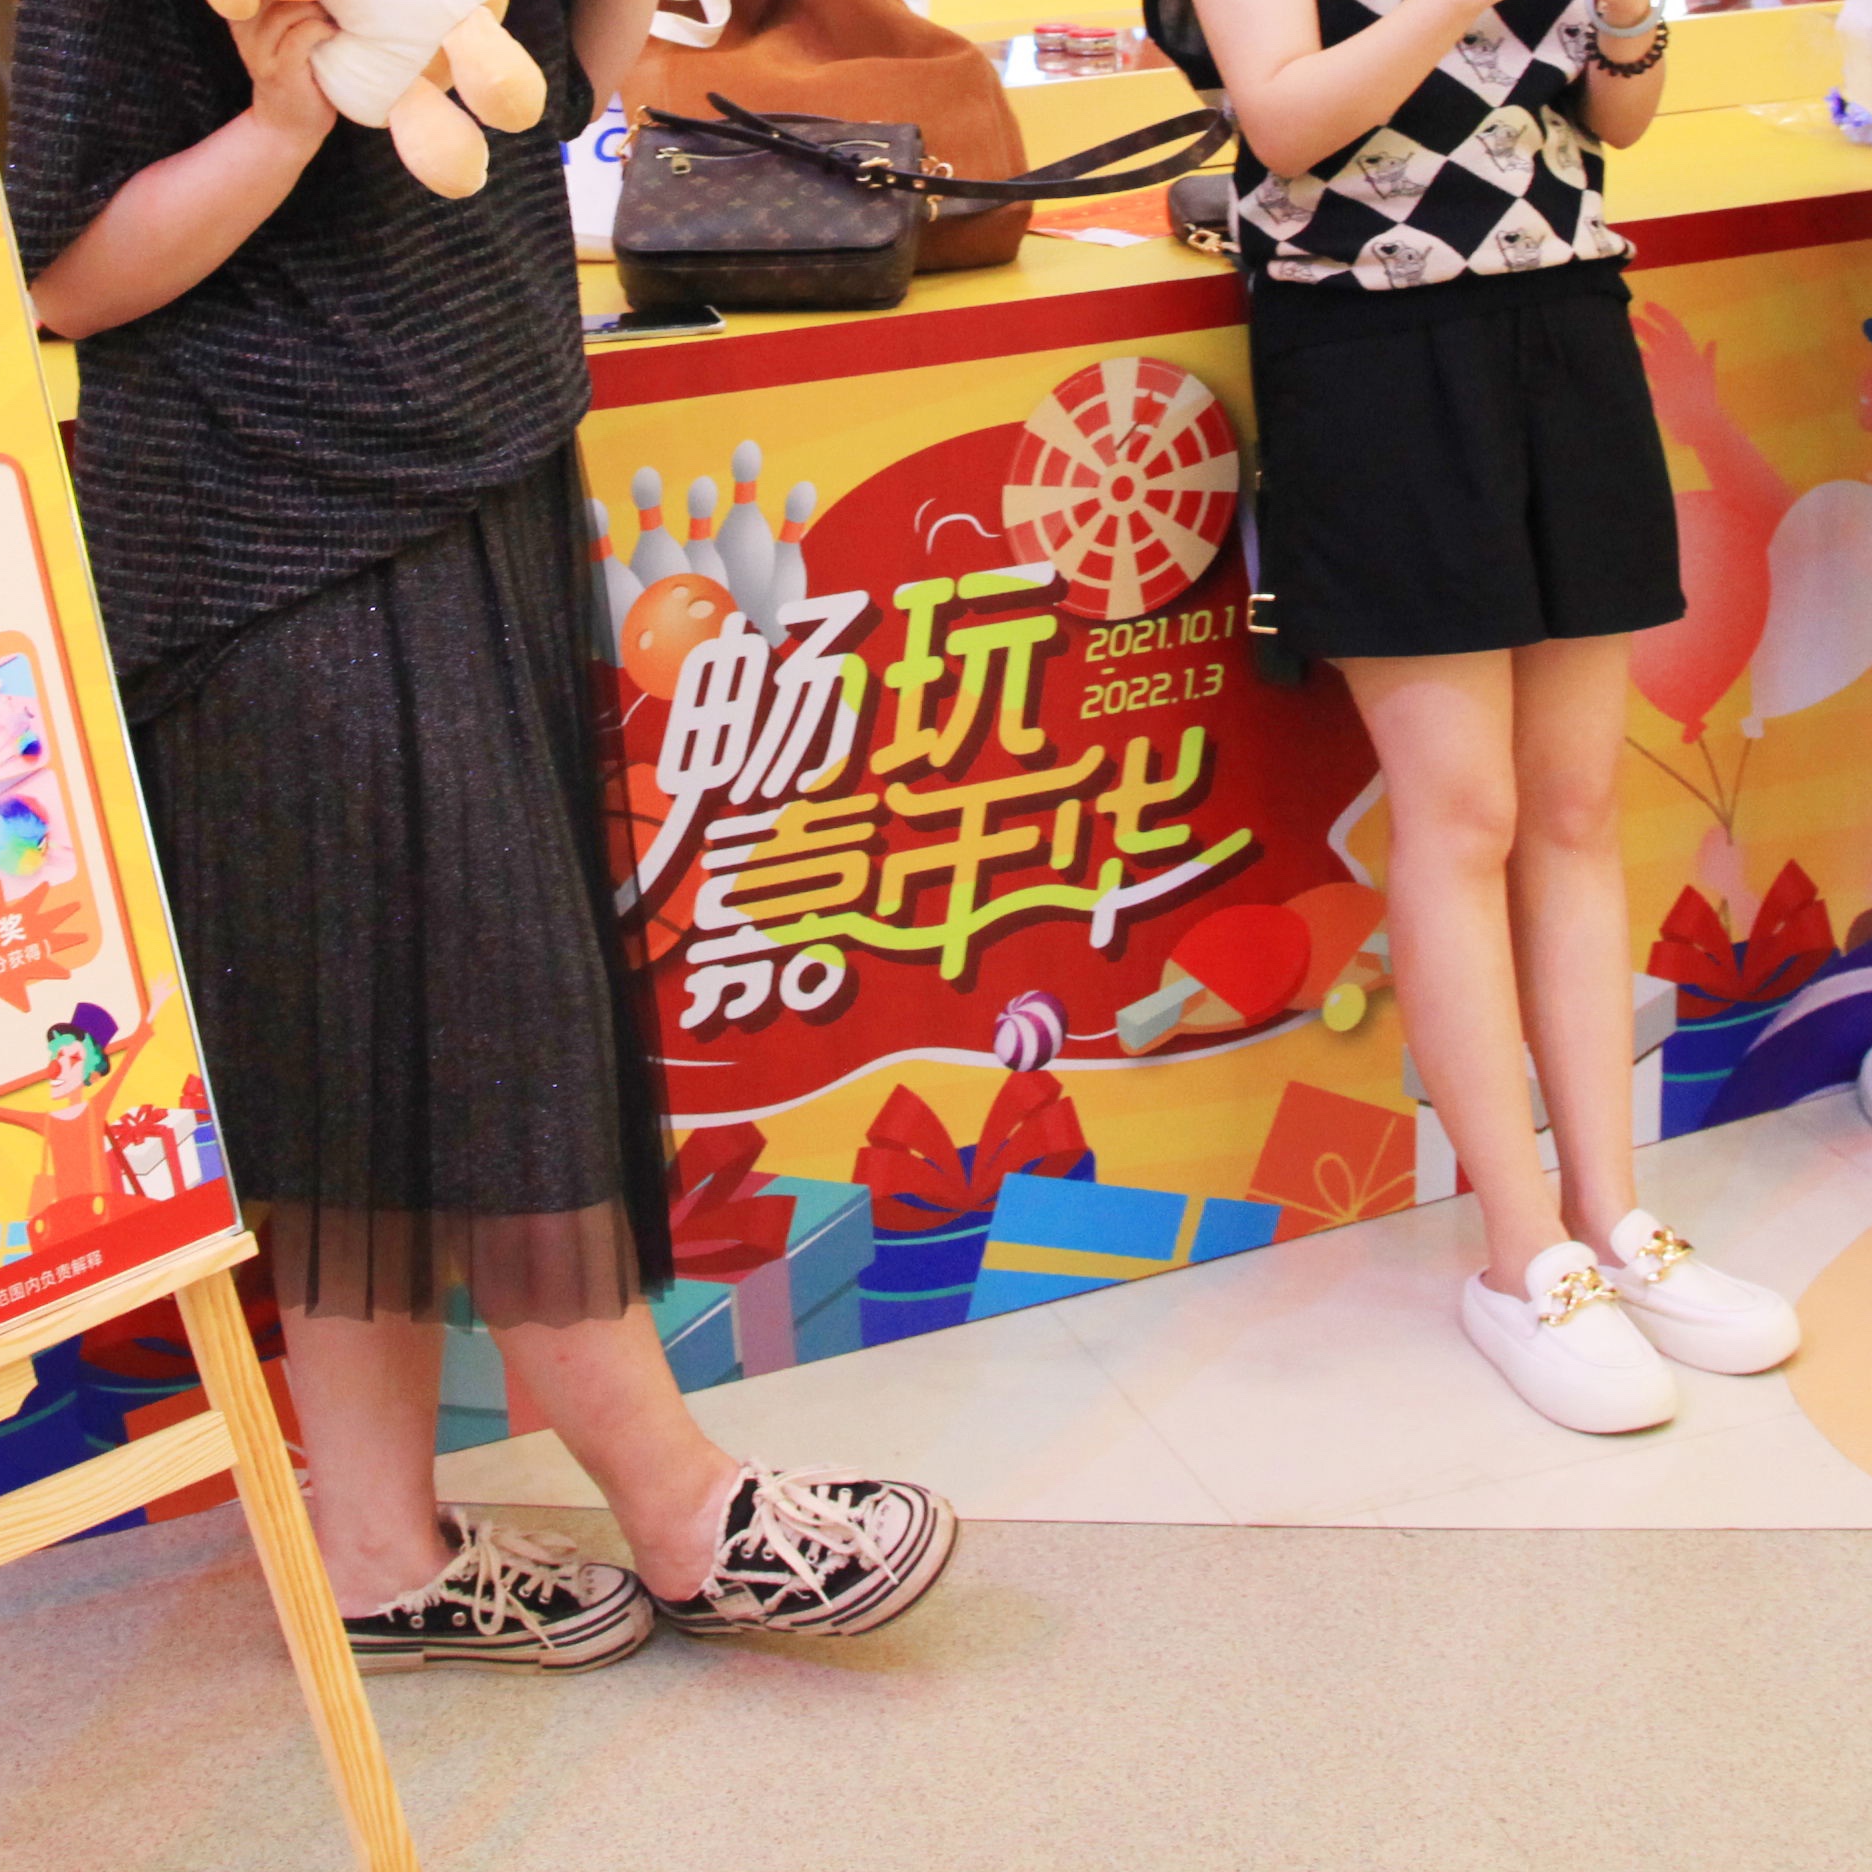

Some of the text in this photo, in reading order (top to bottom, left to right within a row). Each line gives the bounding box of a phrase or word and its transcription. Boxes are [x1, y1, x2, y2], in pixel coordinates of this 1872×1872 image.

[1079, 663, 1225, 720] 2022.1.3
[1084, 605, 1236, 664] 2021.10.1
[615, 561, 1058, 917] 畅玩
[679, 725, 1253, 1029] 嘉年华
